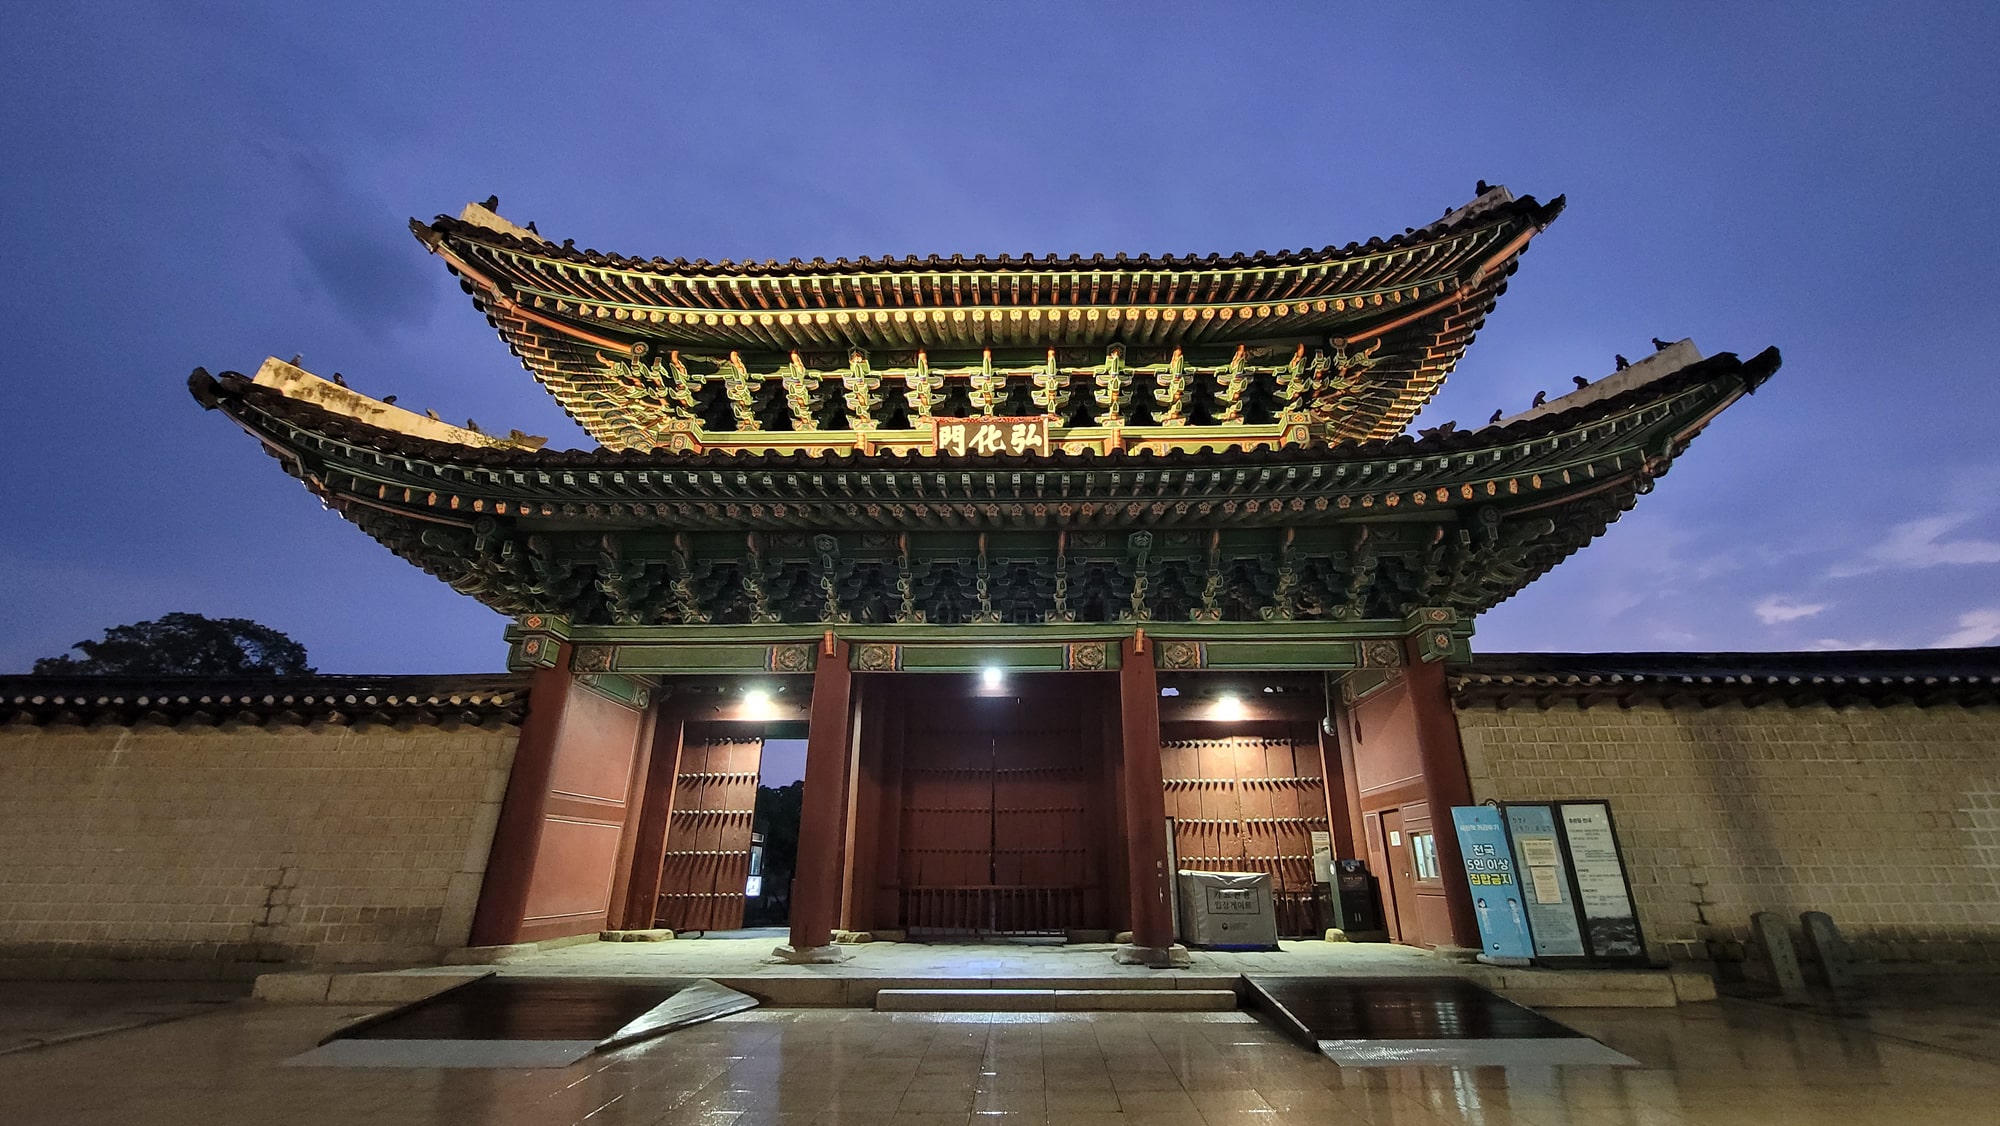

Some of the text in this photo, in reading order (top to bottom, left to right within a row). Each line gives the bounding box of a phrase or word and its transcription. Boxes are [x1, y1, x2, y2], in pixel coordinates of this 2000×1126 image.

[1472, 844, 1495, 856] 전국
[1467, 858, 1509, 871] 5인 이상
[1470, 873, 1513, 886] 집합금지
